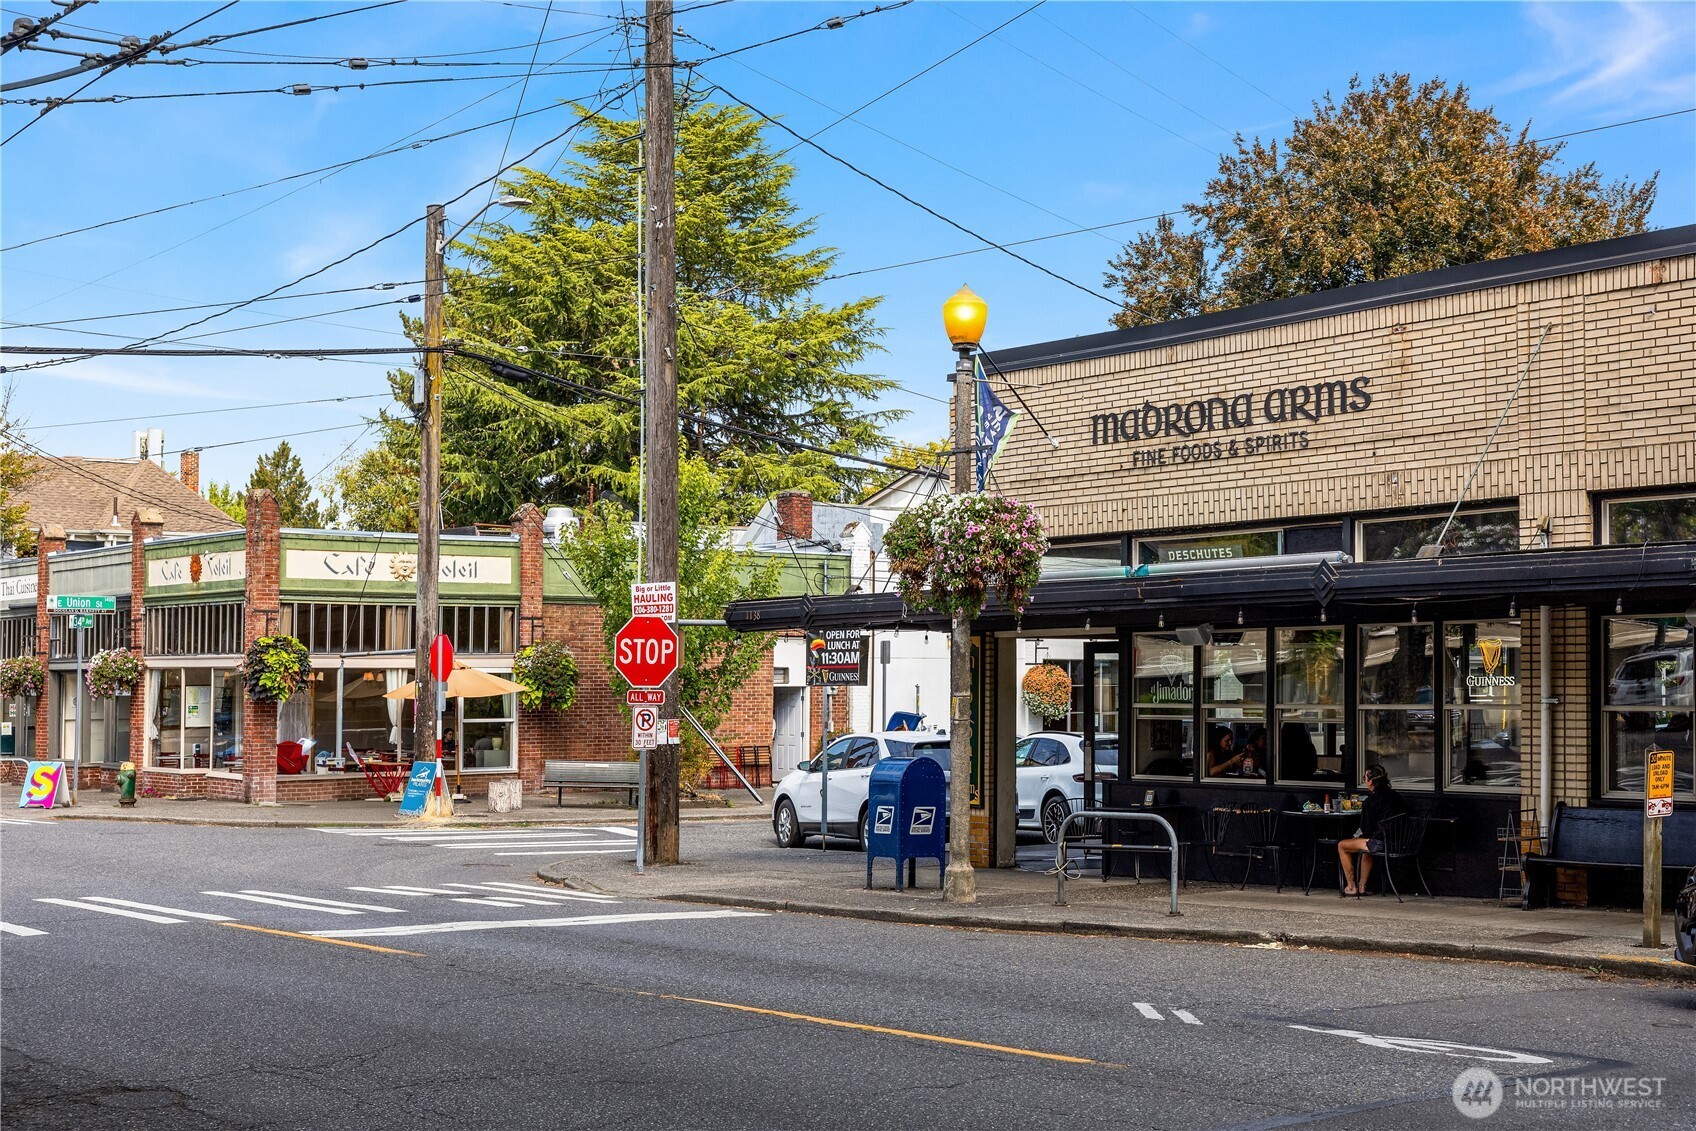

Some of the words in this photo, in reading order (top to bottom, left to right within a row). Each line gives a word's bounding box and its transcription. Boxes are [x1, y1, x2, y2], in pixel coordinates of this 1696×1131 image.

[1132, 448, 1167, 467] FINE
[1172, 440, 1222, 463] FOODS
[1228, 439, 1239, 456] &
[1245, 430, 1310, 455] SPIRITS
[1168, 547, 1233, 561] DESCHUTES
[441, 559, 478, 579] oleil
[1, 581, 15, 597] Thai
[635, 585, 645, 593] Big
[66, 597, 91, 608] Union
[634, 593, 673, 603] HAULING
[826, 630, 845, 640] OPEN
[846, 629, 860, 639] FOR
[619, 638, 674, 665] STOP
[827, 641, 850, 650] LUNCH
[852, 640, 860, 649] AT
[821, 651, 860, 665] 11:30AM
[1466, 675, 1516, 687] GUINNESS
[1152, 680, 1194, 704] Jimador
[1650, 755, 1657, 763] 30
